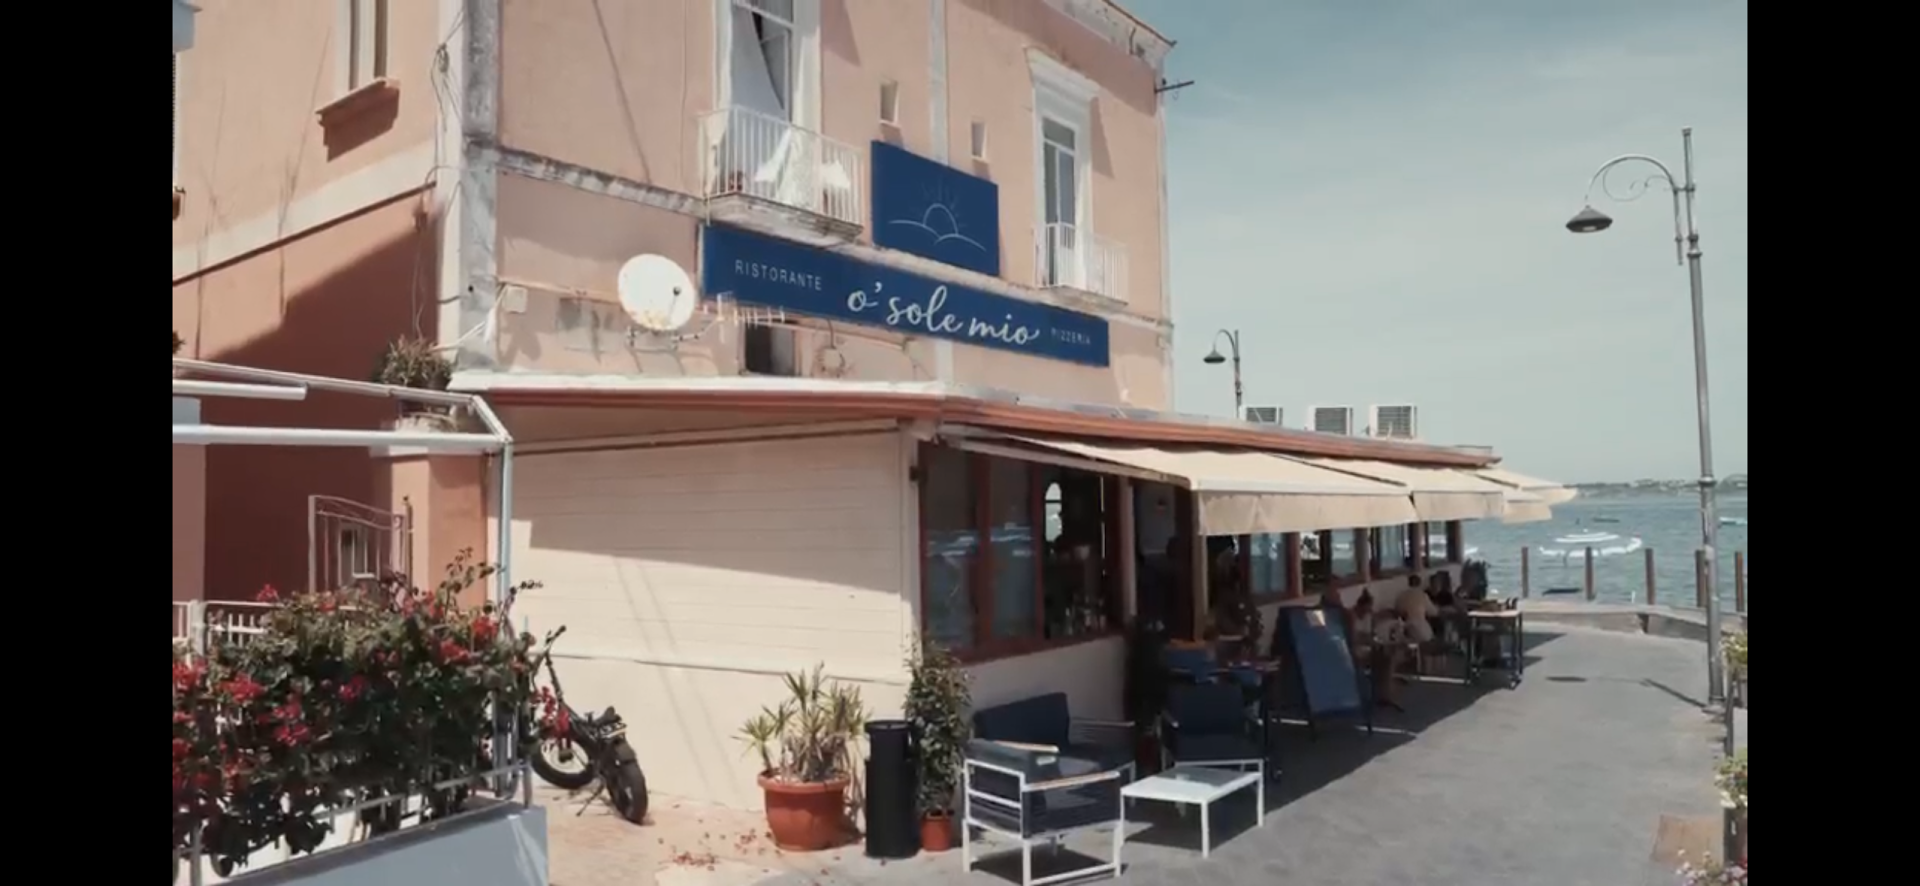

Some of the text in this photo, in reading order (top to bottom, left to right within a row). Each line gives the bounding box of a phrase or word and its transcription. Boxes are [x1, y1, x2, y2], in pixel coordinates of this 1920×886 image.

[735, 259, 822, 291] RISTORANTE
[886, 285, 964, 333] sole
[968, 314, 1040, 345] mio
